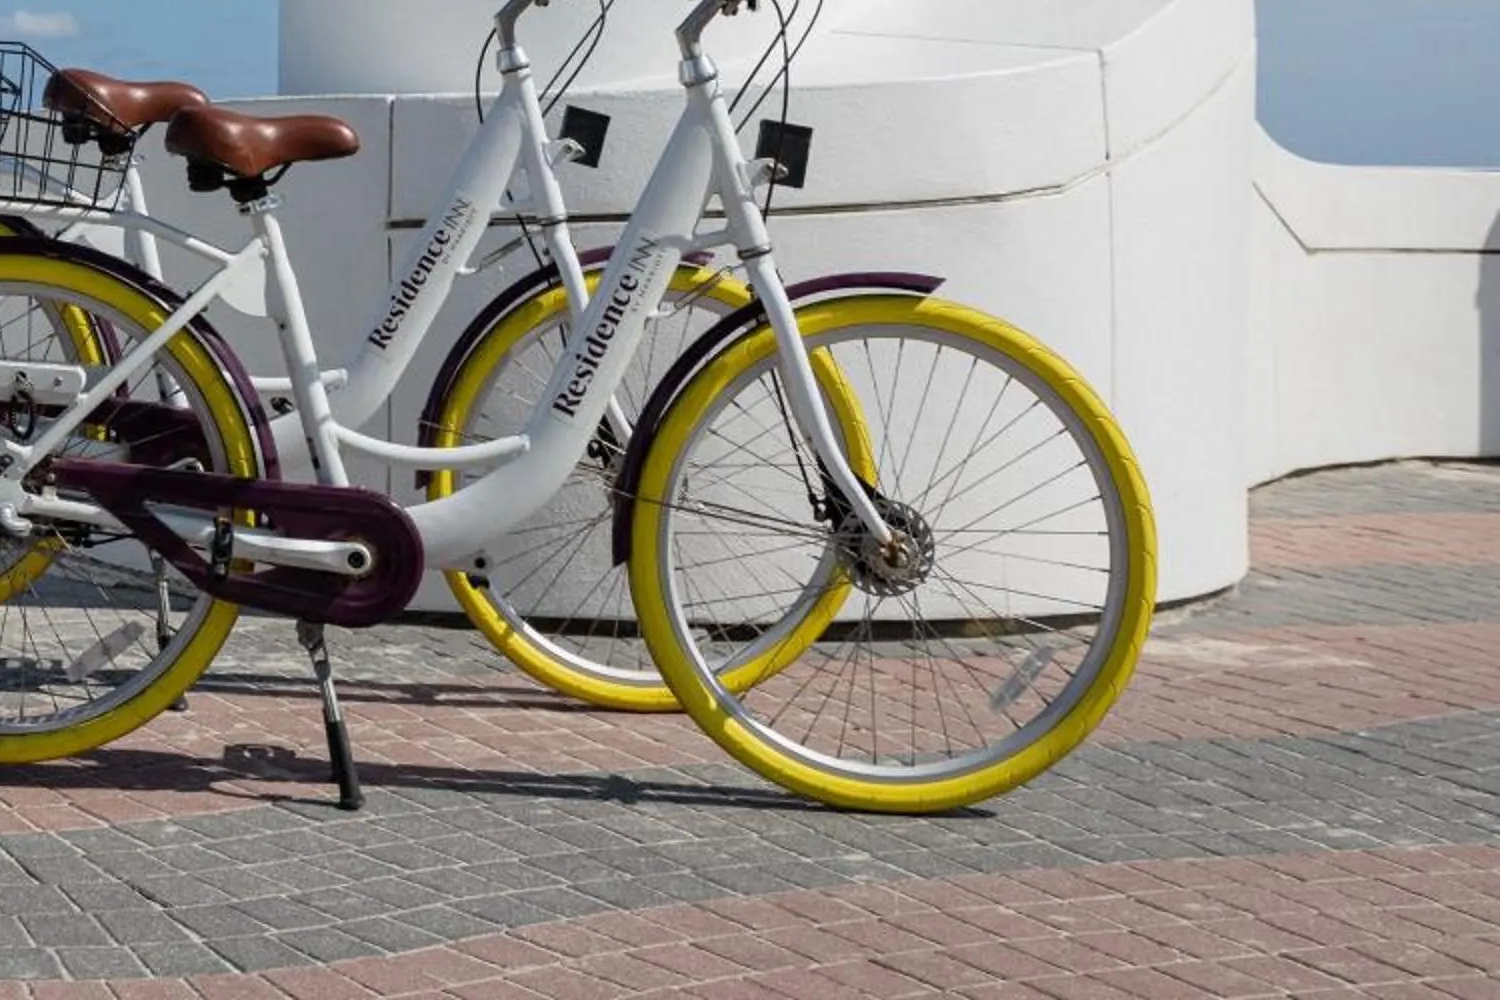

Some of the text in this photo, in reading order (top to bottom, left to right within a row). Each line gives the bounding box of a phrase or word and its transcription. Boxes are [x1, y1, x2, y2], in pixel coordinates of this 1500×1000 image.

[368, 229, 451, 350] Residence
[553, 274, 639, 418] Residence
[627, 236, 658, 273] INN
